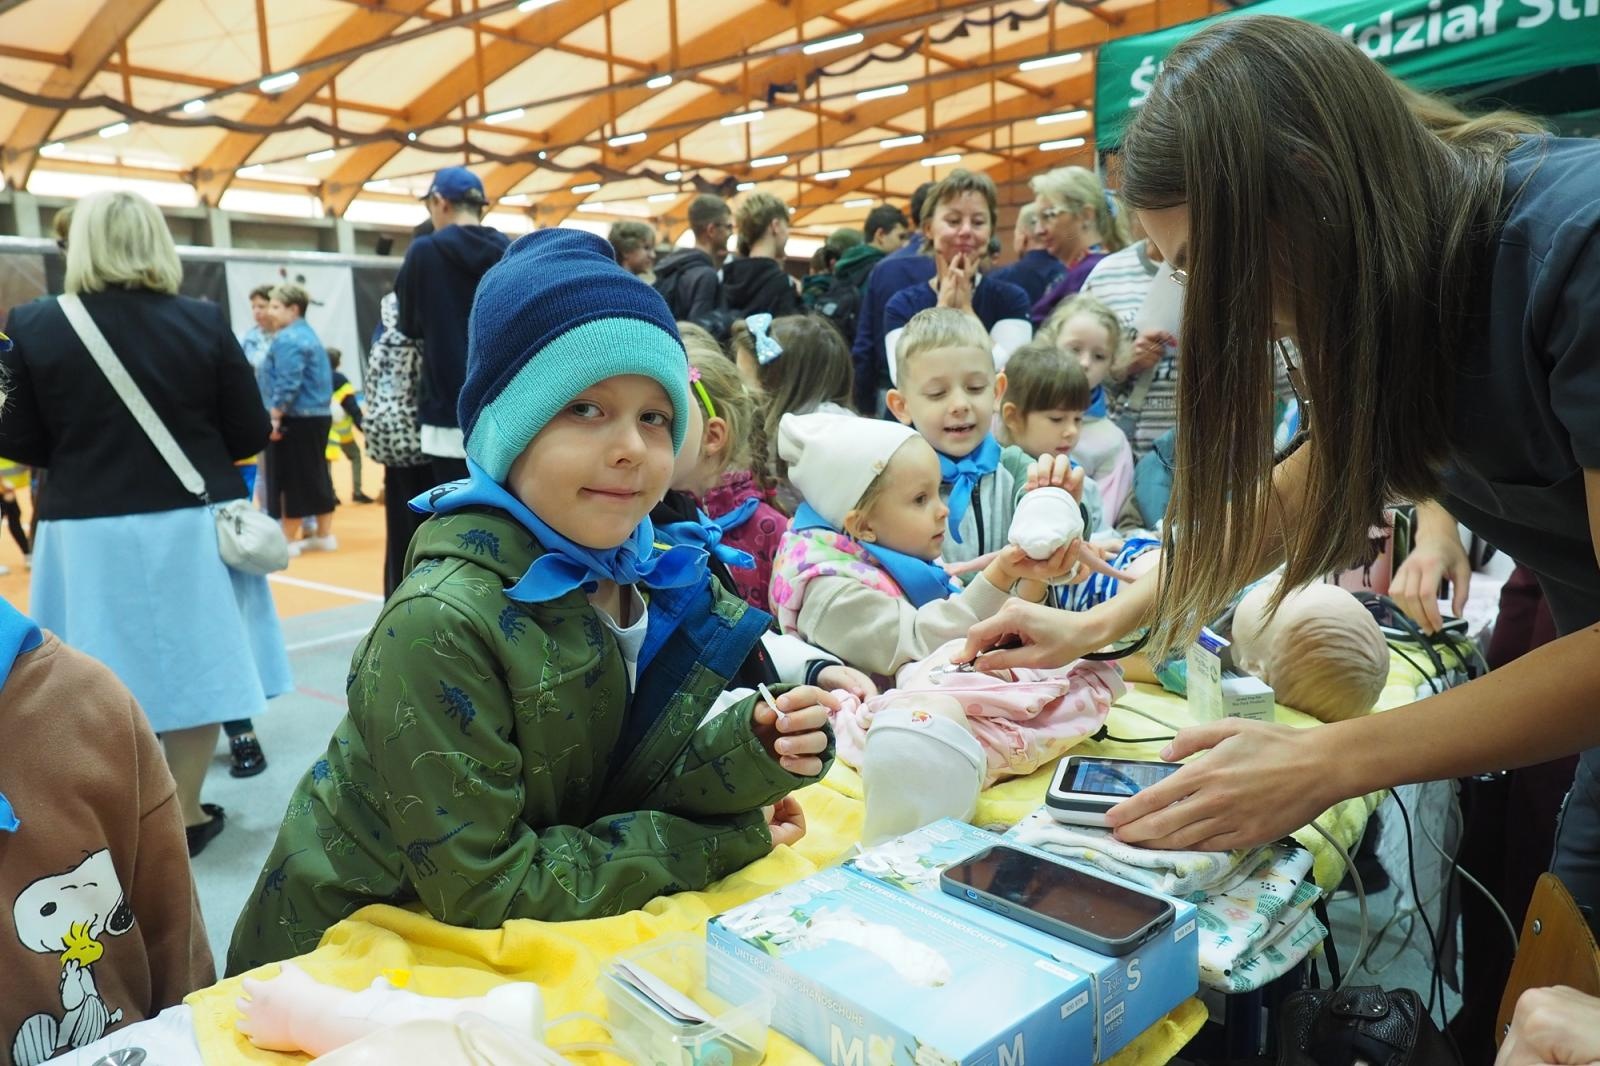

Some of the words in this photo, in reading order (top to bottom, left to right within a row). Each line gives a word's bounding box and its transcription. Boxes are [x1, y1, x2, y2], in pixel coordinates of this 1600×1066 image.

[734, 944, 865, 1027] UNTERSUCHUNGSHANDSCHUHE
[1126, 958, 1142, 991] S
[831, 1023, 864, 1066] M
[997, 1032, 1025, 1066] M
